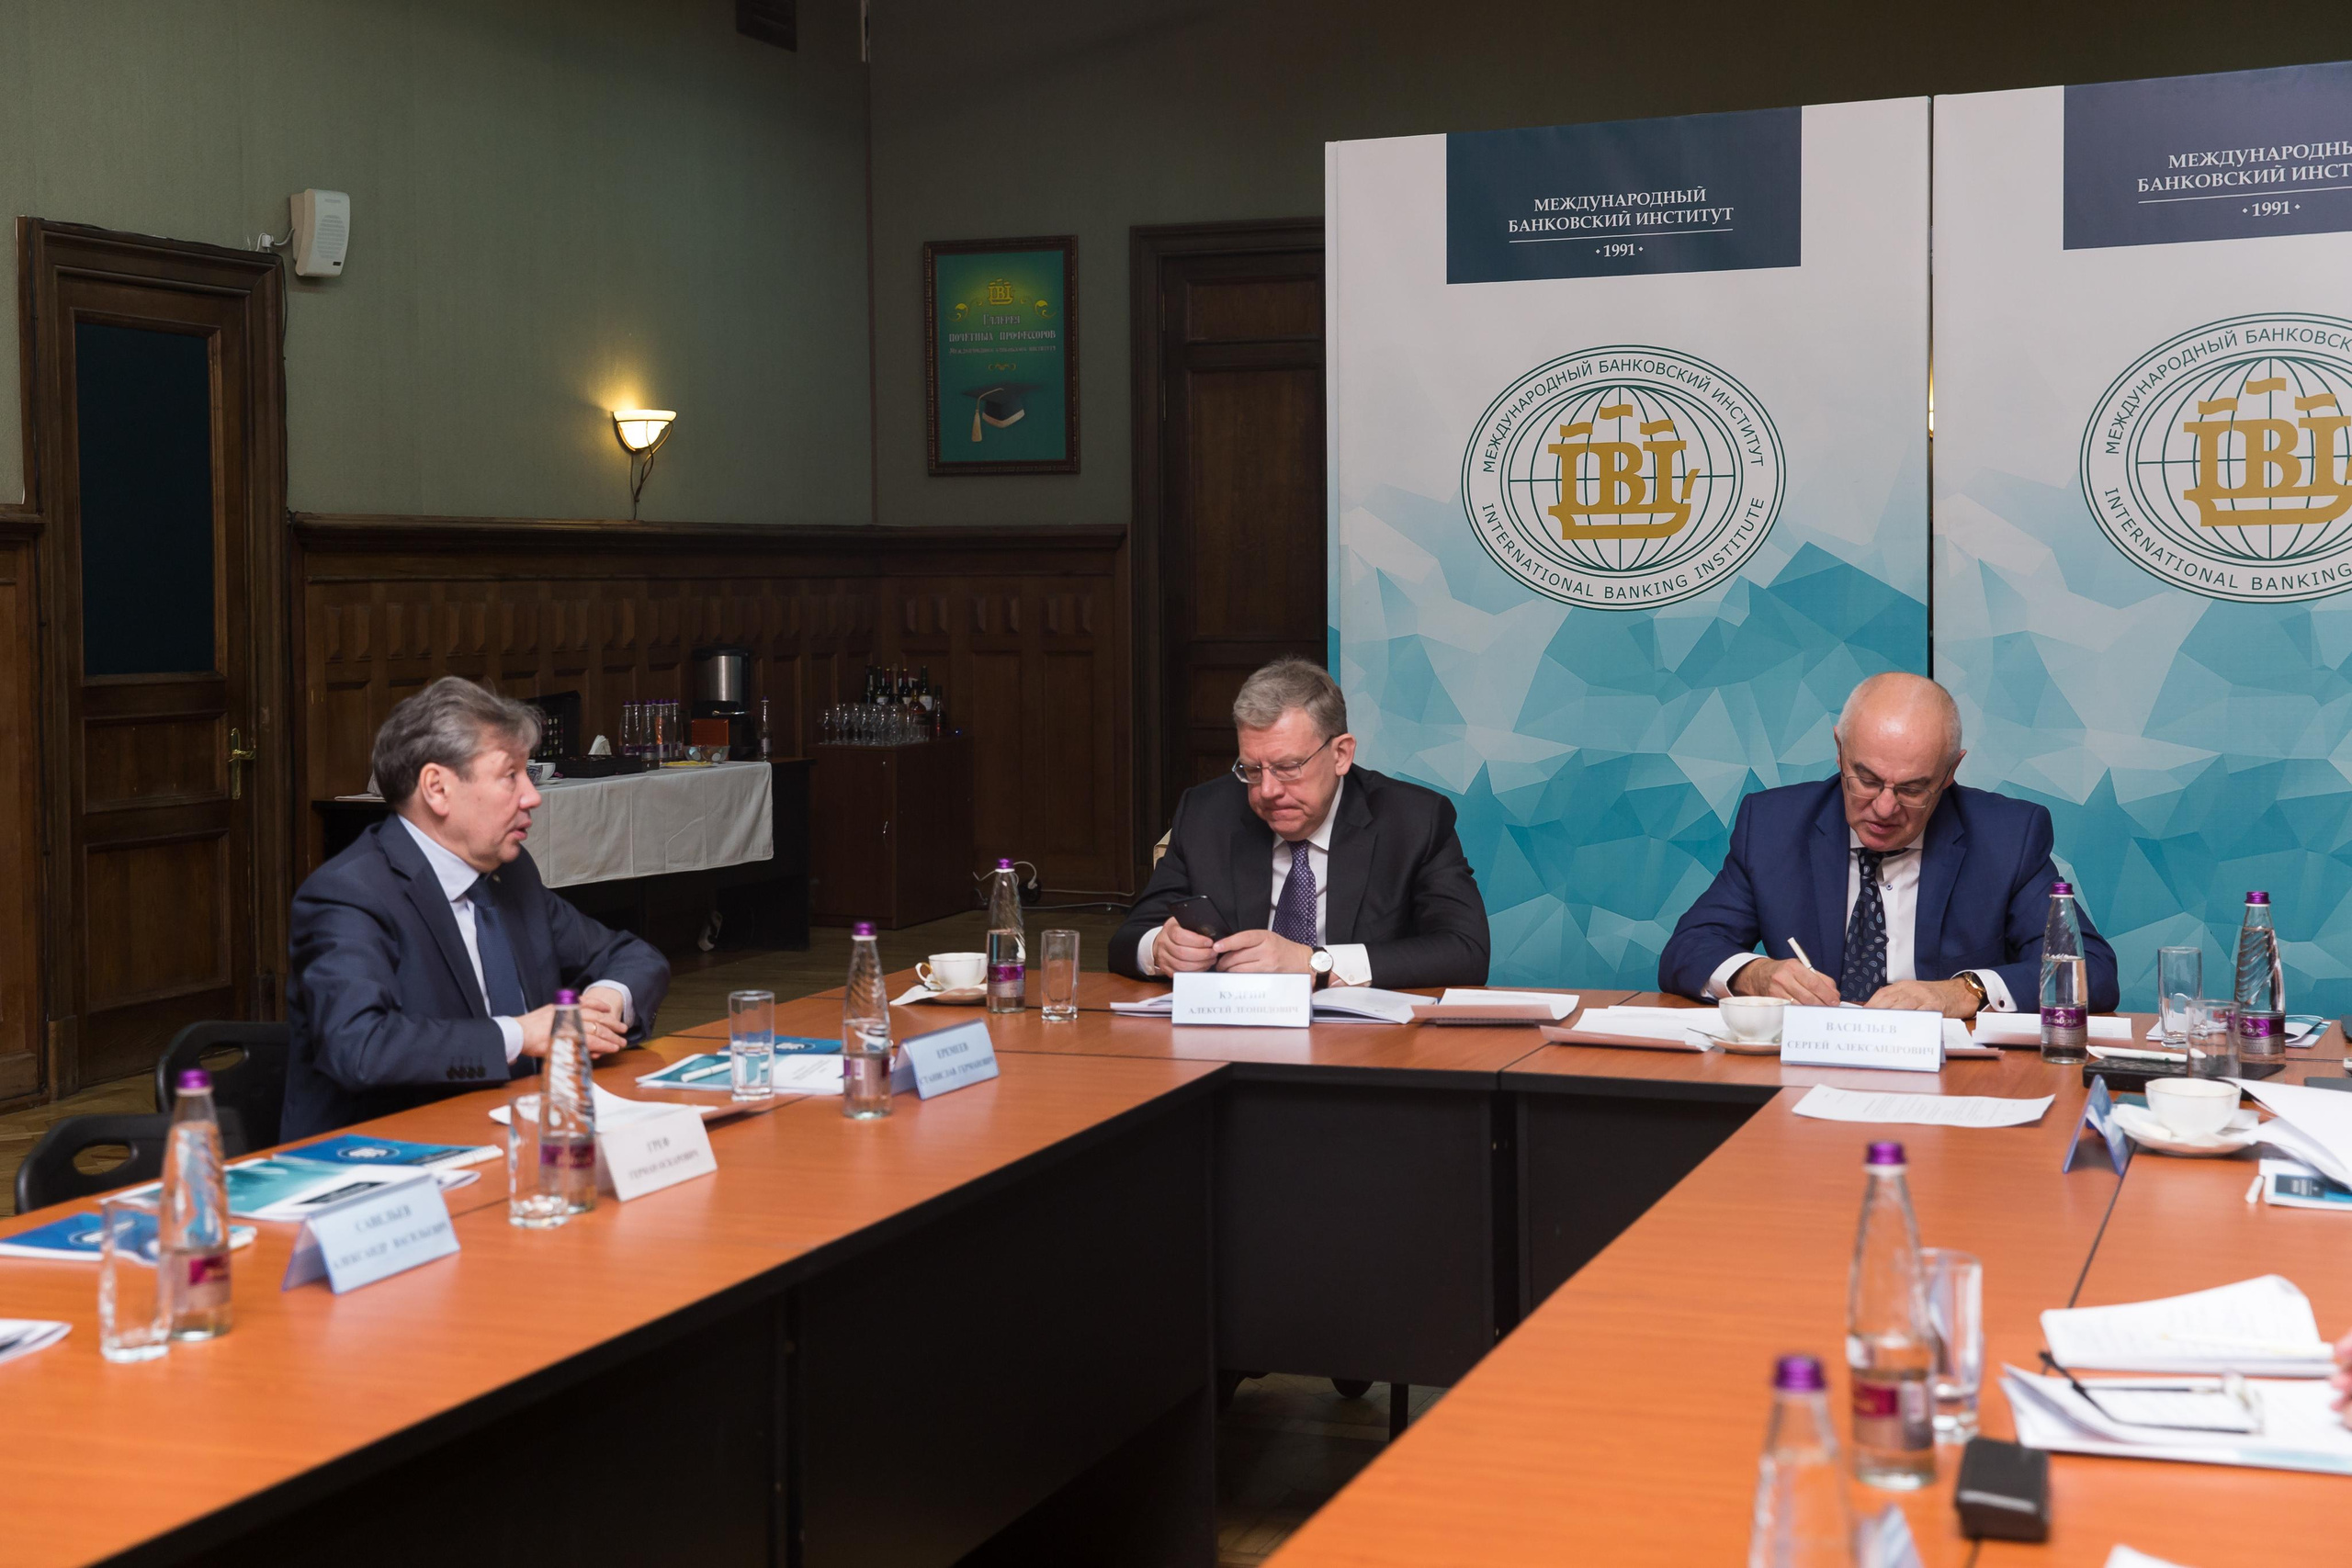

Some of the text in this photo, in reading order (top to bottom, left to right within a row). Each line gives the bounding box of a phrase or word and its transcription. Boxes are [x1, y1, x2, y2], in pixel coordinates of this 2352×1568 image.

[2137, 164, 2286, 194] БАНКОВСКИЙ
[1533, 186, 1707, 212] МЕЖДУНАРОДНЫЙ
[2251, 200, 2290, 218] 1991
[1508, 207, 1734, 233] БАНКОВСКИЙ ИНСТИТУТ
[1603, 243, 1636, 258] 1991
[2105, 330, 2238, 455] МЕЖДУНАРОДНЫЙ
[1482, 358, 1765, 473] МЕЖДУНАРОДНЫЙ БАНКОВСКИЙ ИНСТИТУТ
[1482, 497, 1765, 600] INTERNATIONAL BANKING INSTITUTE
[2104, 487, 2352, 592] INTERNATIONAL BANKING
[1826, 1021, 1897, 1034] ВАСИЛЬЕВ
[1787, 1039, 1935, 1056] СЕРГЕЙ АЛЕКСАНДРОВИЧ
